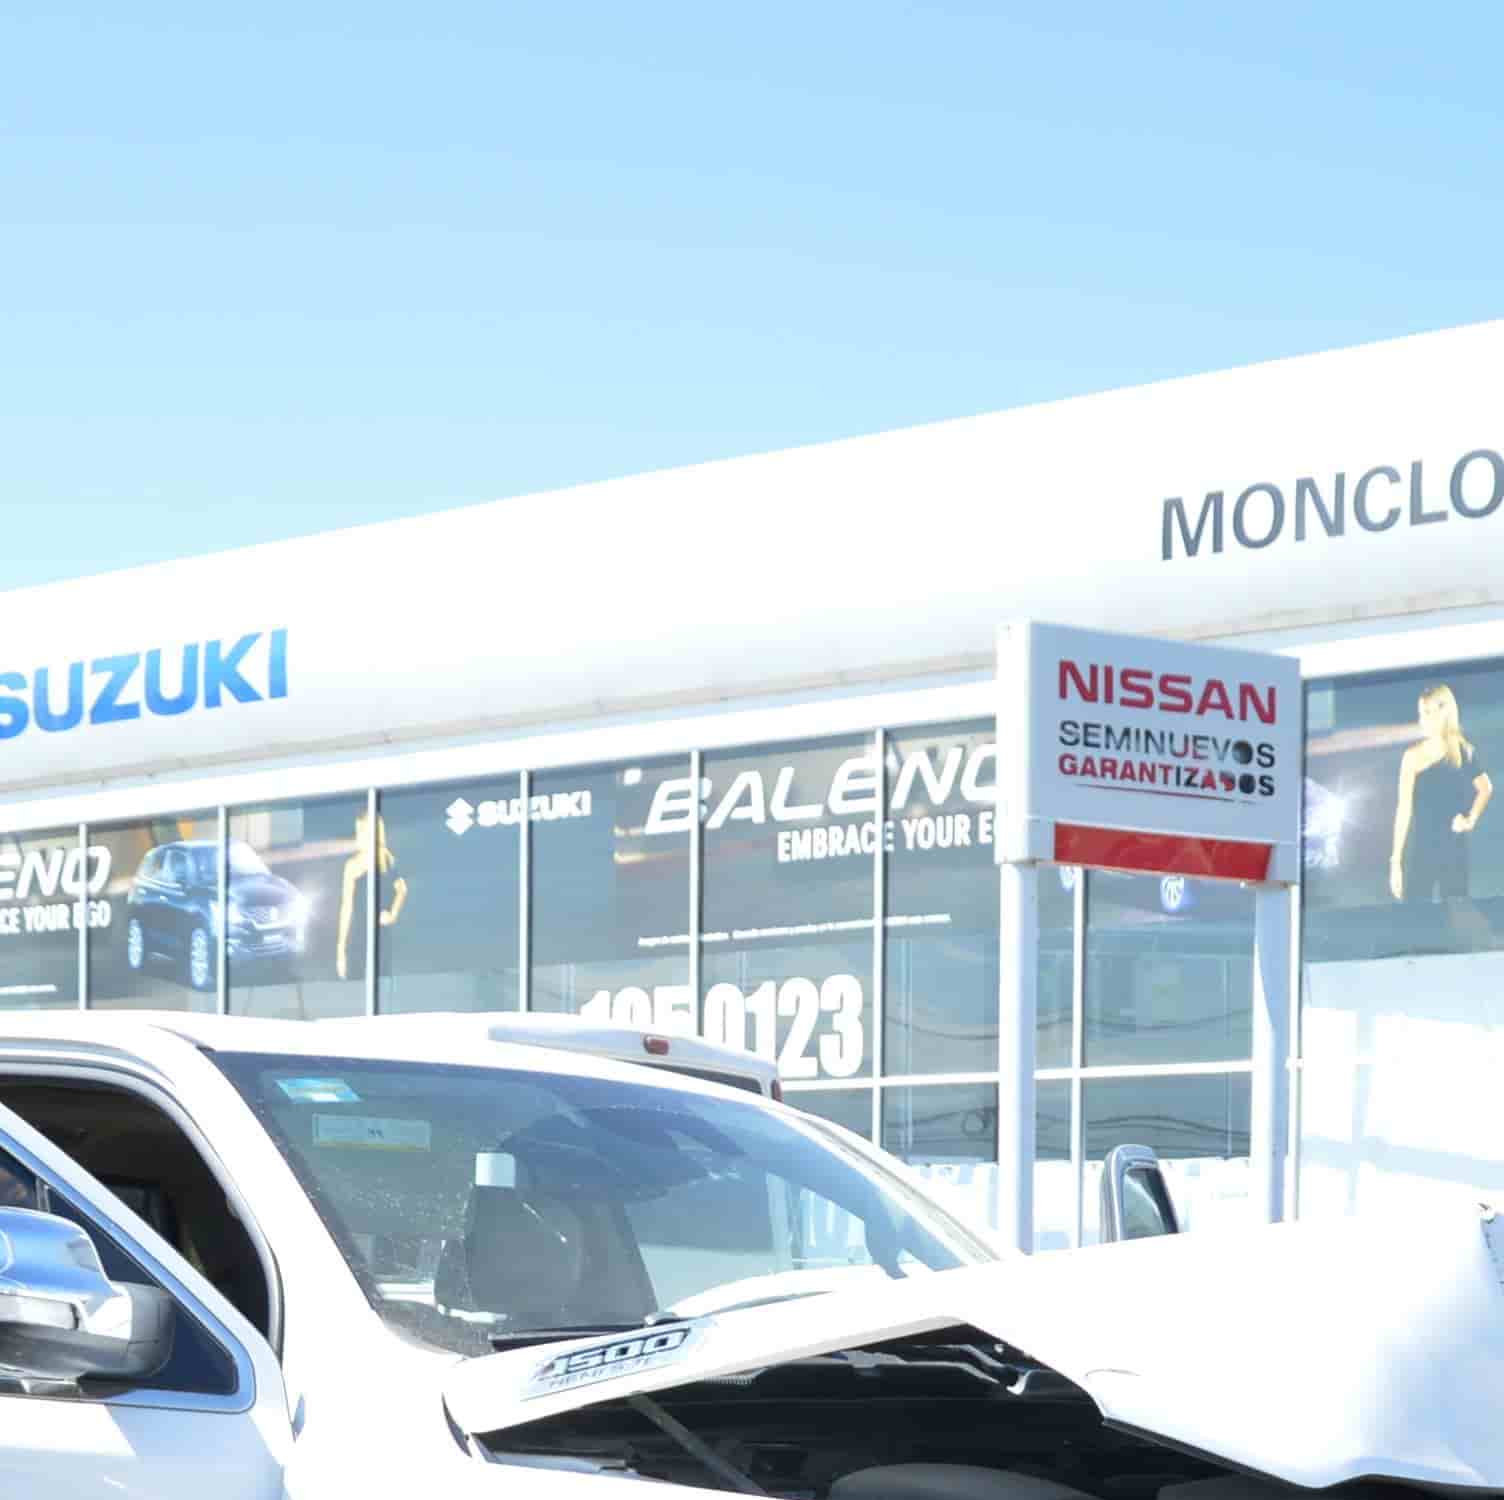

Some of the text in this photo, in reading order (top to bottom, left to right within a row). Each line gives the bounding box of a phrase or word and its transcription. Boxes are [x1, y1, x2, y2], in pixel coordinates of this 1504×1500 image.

[1058, 660, 1277, 725] NISSAN
[1058, 719, 1276, 768] SEMINUEVOS
[1057, 752, 1276, 797] GARANTIZADOS
[477, 789, 593, 827] SUZUKI
[776, 821, 895, 864] EMBRACE
[900, 814, 972, 850] YOUR
[22, 901, 70, 933] YOUR
[539, 1327, 691, 1378] 1500
